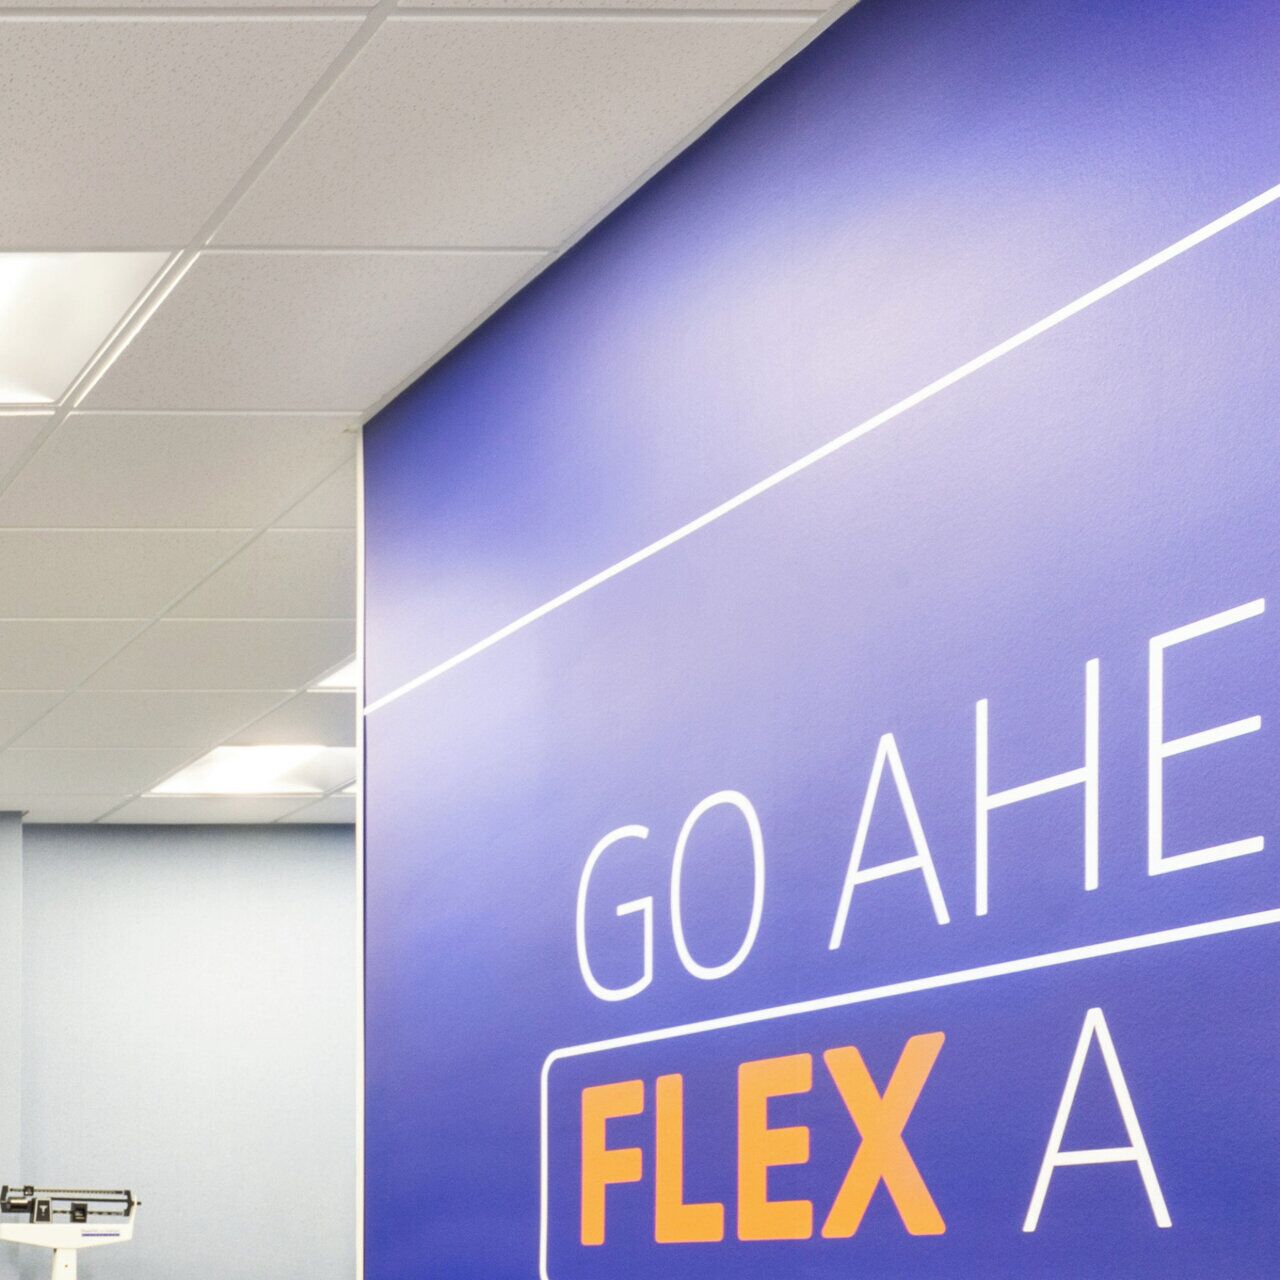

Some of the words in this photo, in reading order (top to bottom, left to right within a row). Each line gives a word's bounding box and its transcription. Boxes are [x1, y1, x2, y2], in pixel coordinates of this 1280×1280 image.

[575, 789, 766, 1002] GO
[828, 597, 1266, 951] AHE
[581, 1031, 946, 1246] FLEX
[1022, 1006, 1173, 1233] A
